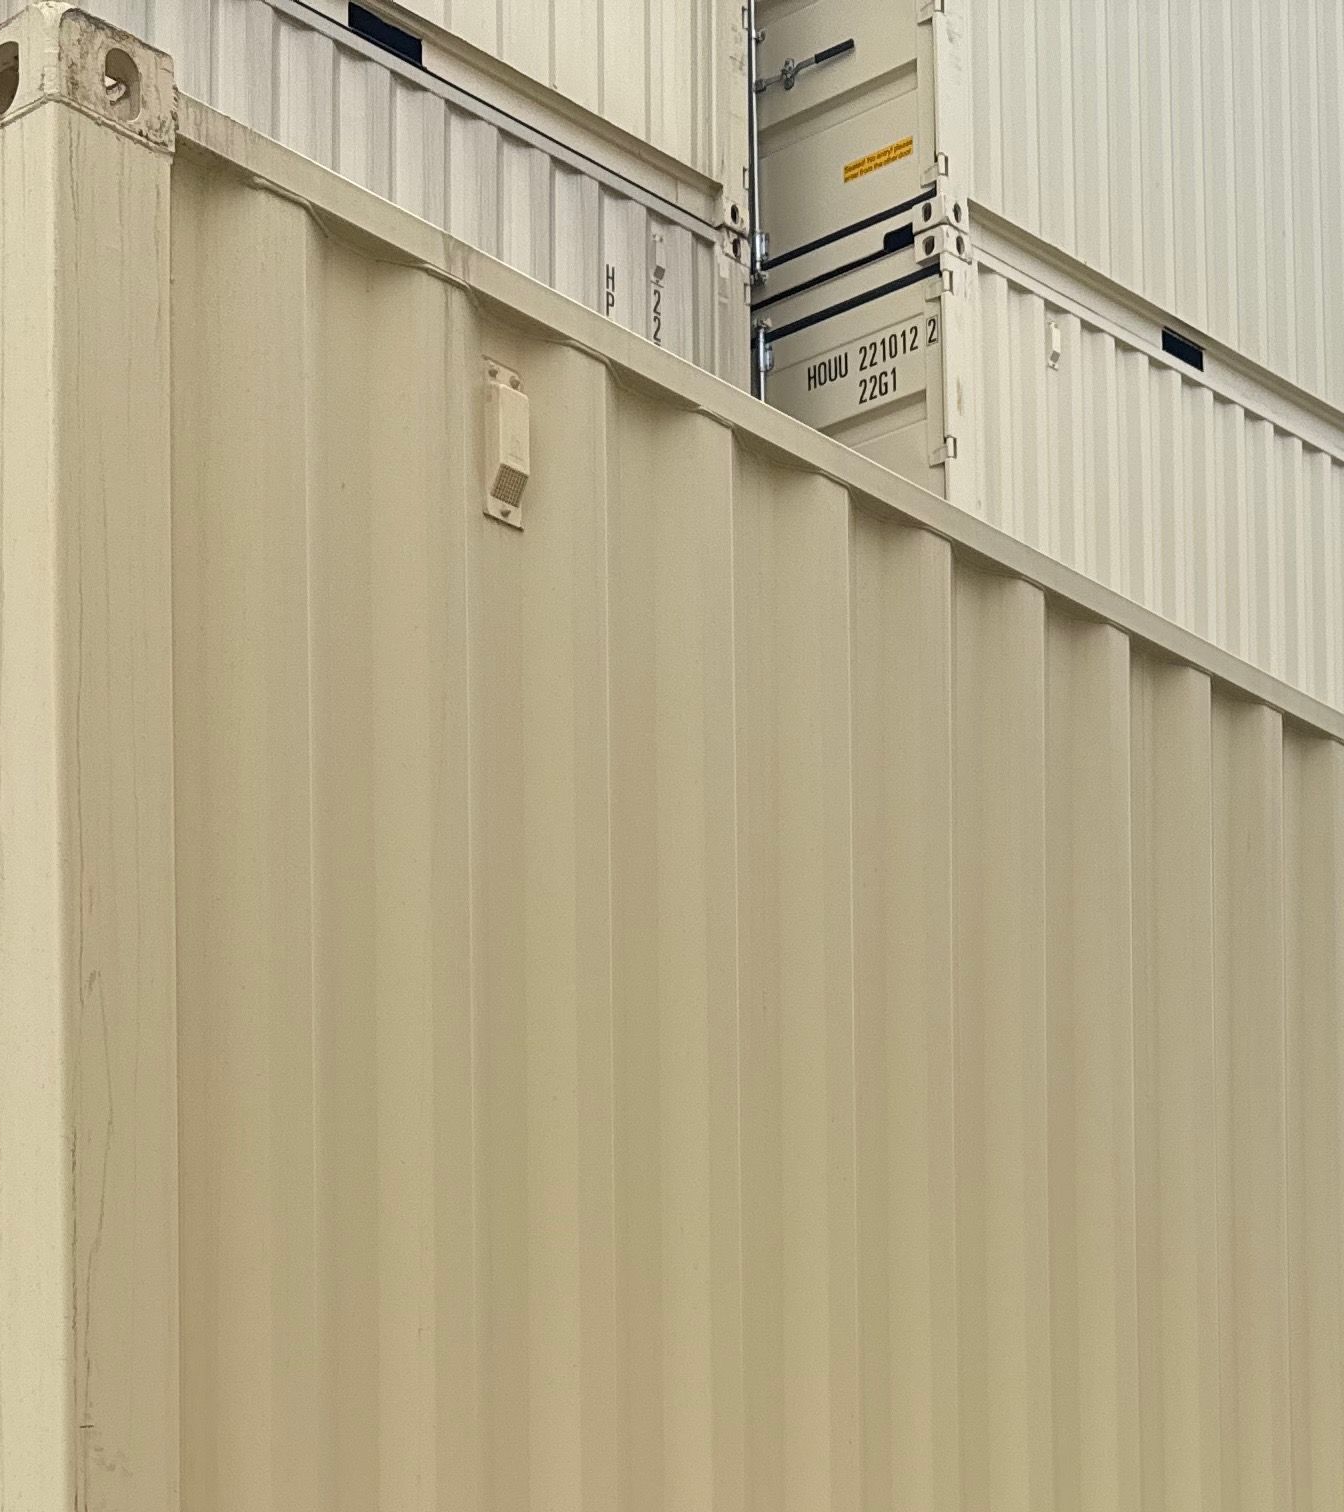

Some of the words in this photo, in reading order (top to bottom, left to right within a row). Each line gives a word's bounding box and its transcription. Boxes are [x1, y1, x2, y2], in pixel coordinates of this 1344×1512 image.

[807, 352, 849, 391] HOUU
[859, 326, 919, 371] 221012
[927, 318, 938, 343] 2
[859, 367, 898, 404] 22G1
